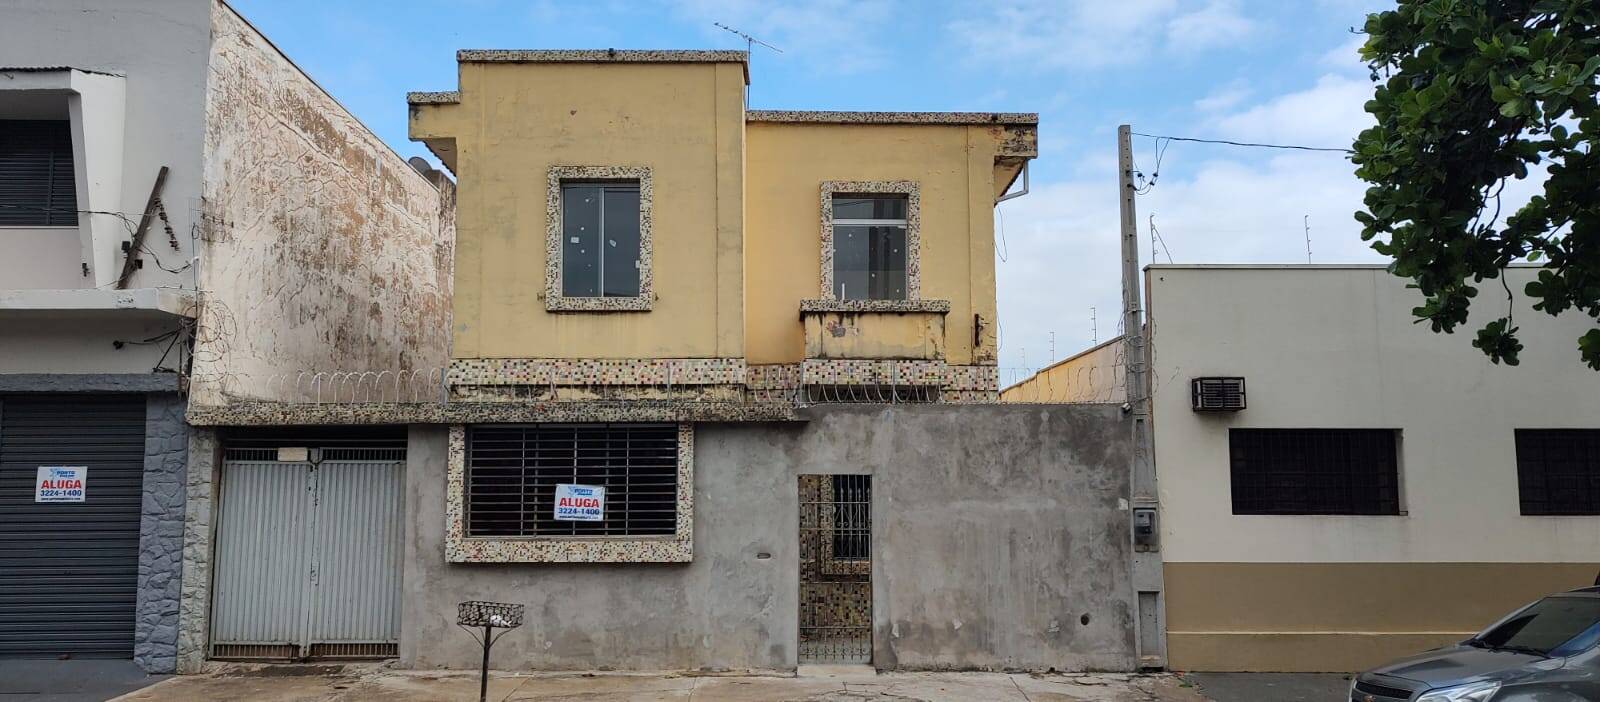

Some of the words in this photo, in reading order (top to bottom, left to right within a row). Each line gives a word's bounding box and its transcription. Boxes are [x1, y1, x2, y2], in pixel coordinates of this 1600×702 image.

[41, 480, 81, 489] ALUGA
[559, 497, 600, 508] ALUGA
[558, 507, 600, 515] 3224-1400
